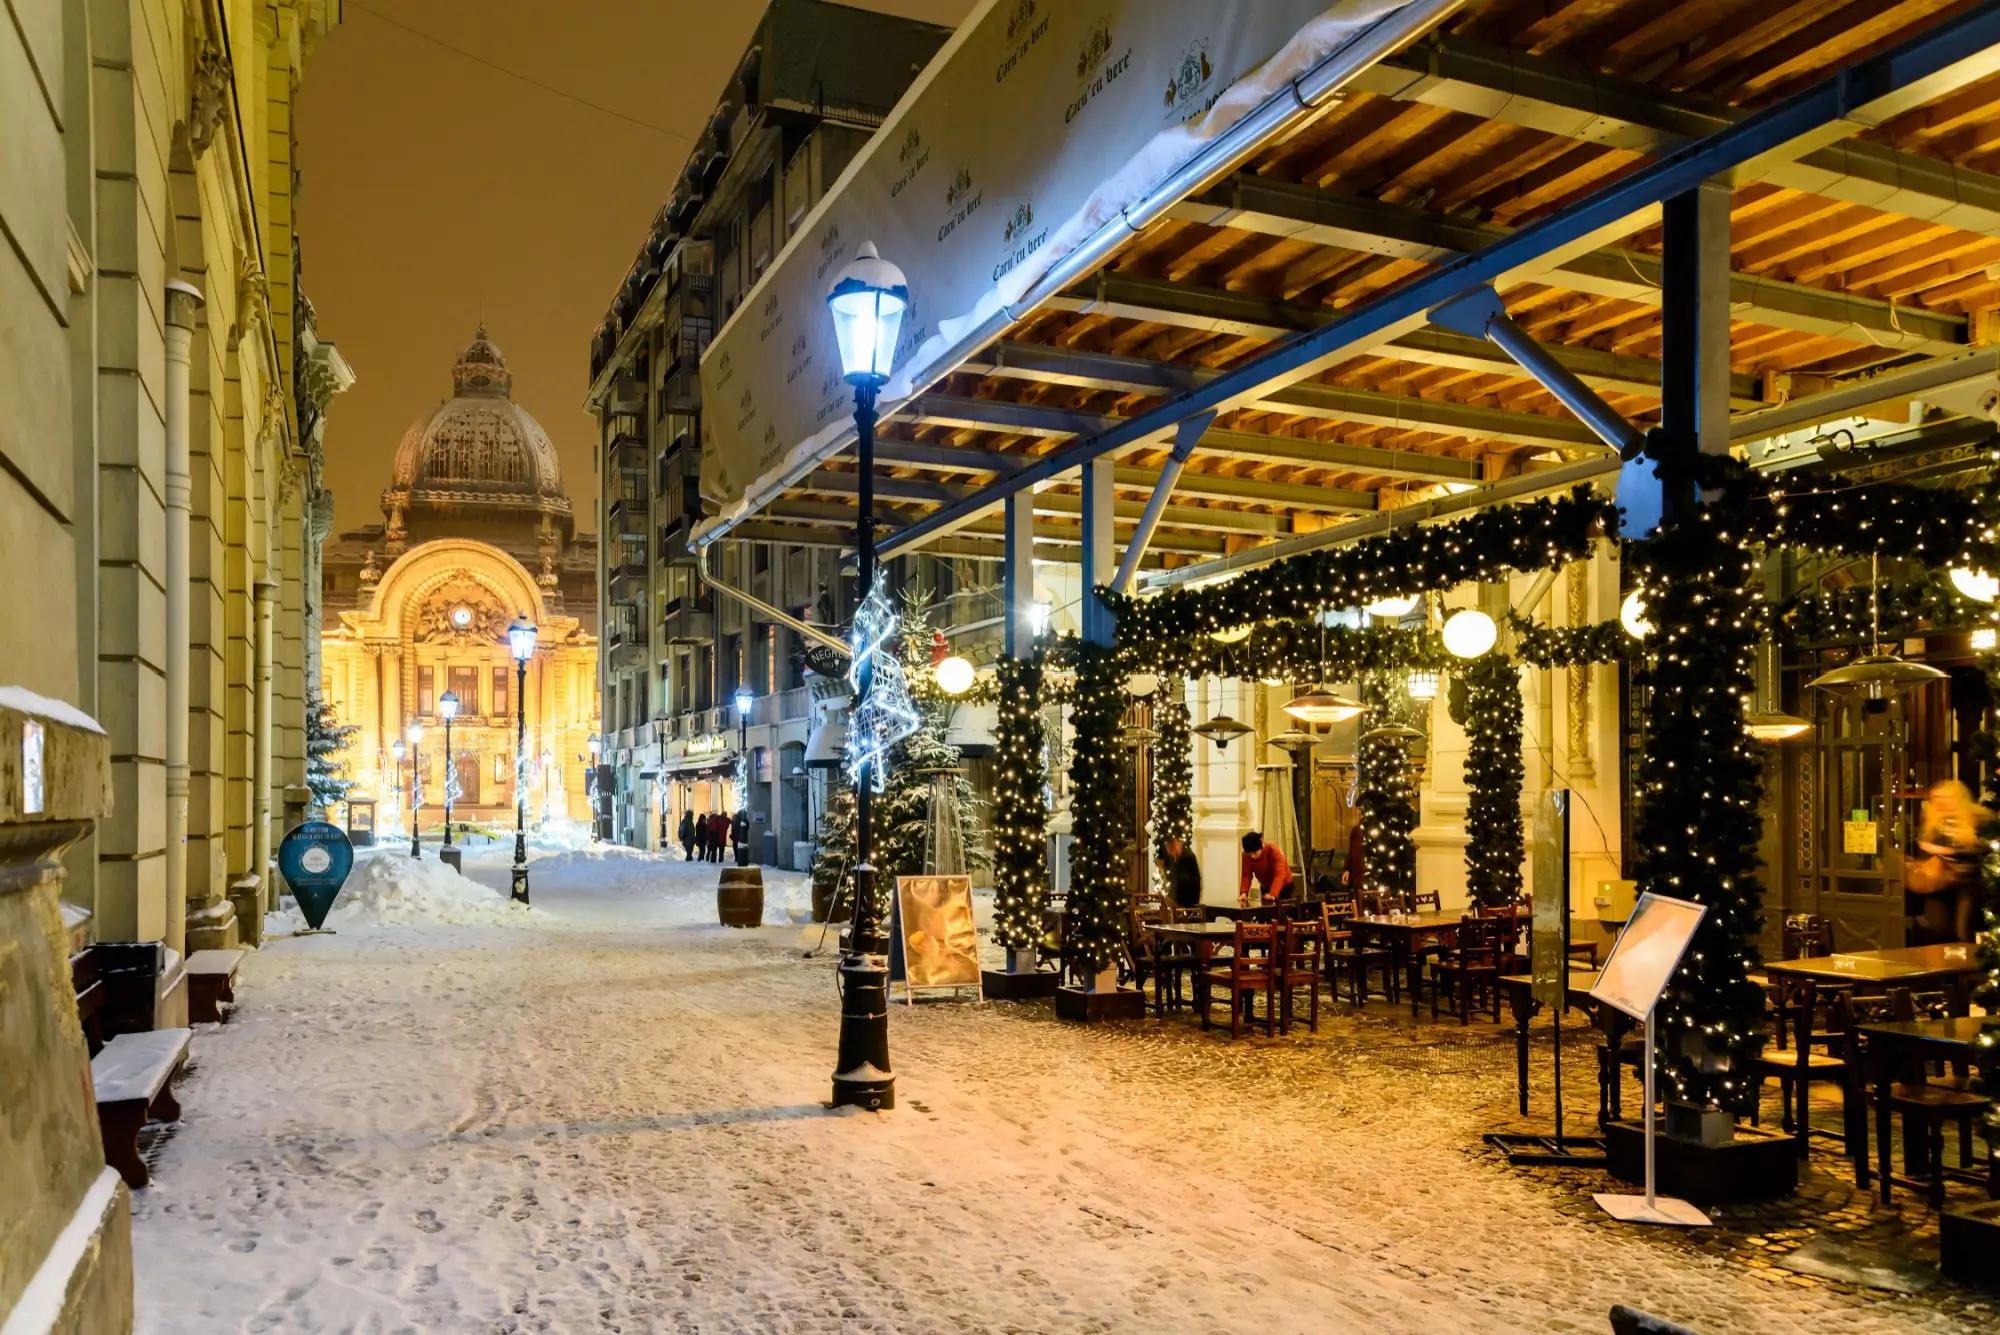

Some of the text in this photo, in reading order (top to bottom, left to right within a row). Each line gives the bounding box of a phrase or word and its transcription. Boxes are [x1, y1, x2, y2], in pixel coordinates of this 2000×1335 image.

[1020, 39, 1029, 58] cu
[1031, 17, 1049, 45] bere
[1065, 54, 1129, 124] Caru' cu bere
[957, 209, 966, 225] cu
[993, 251, 1015, 282] Caru'
[1016, 247, 1026, 264] cu
